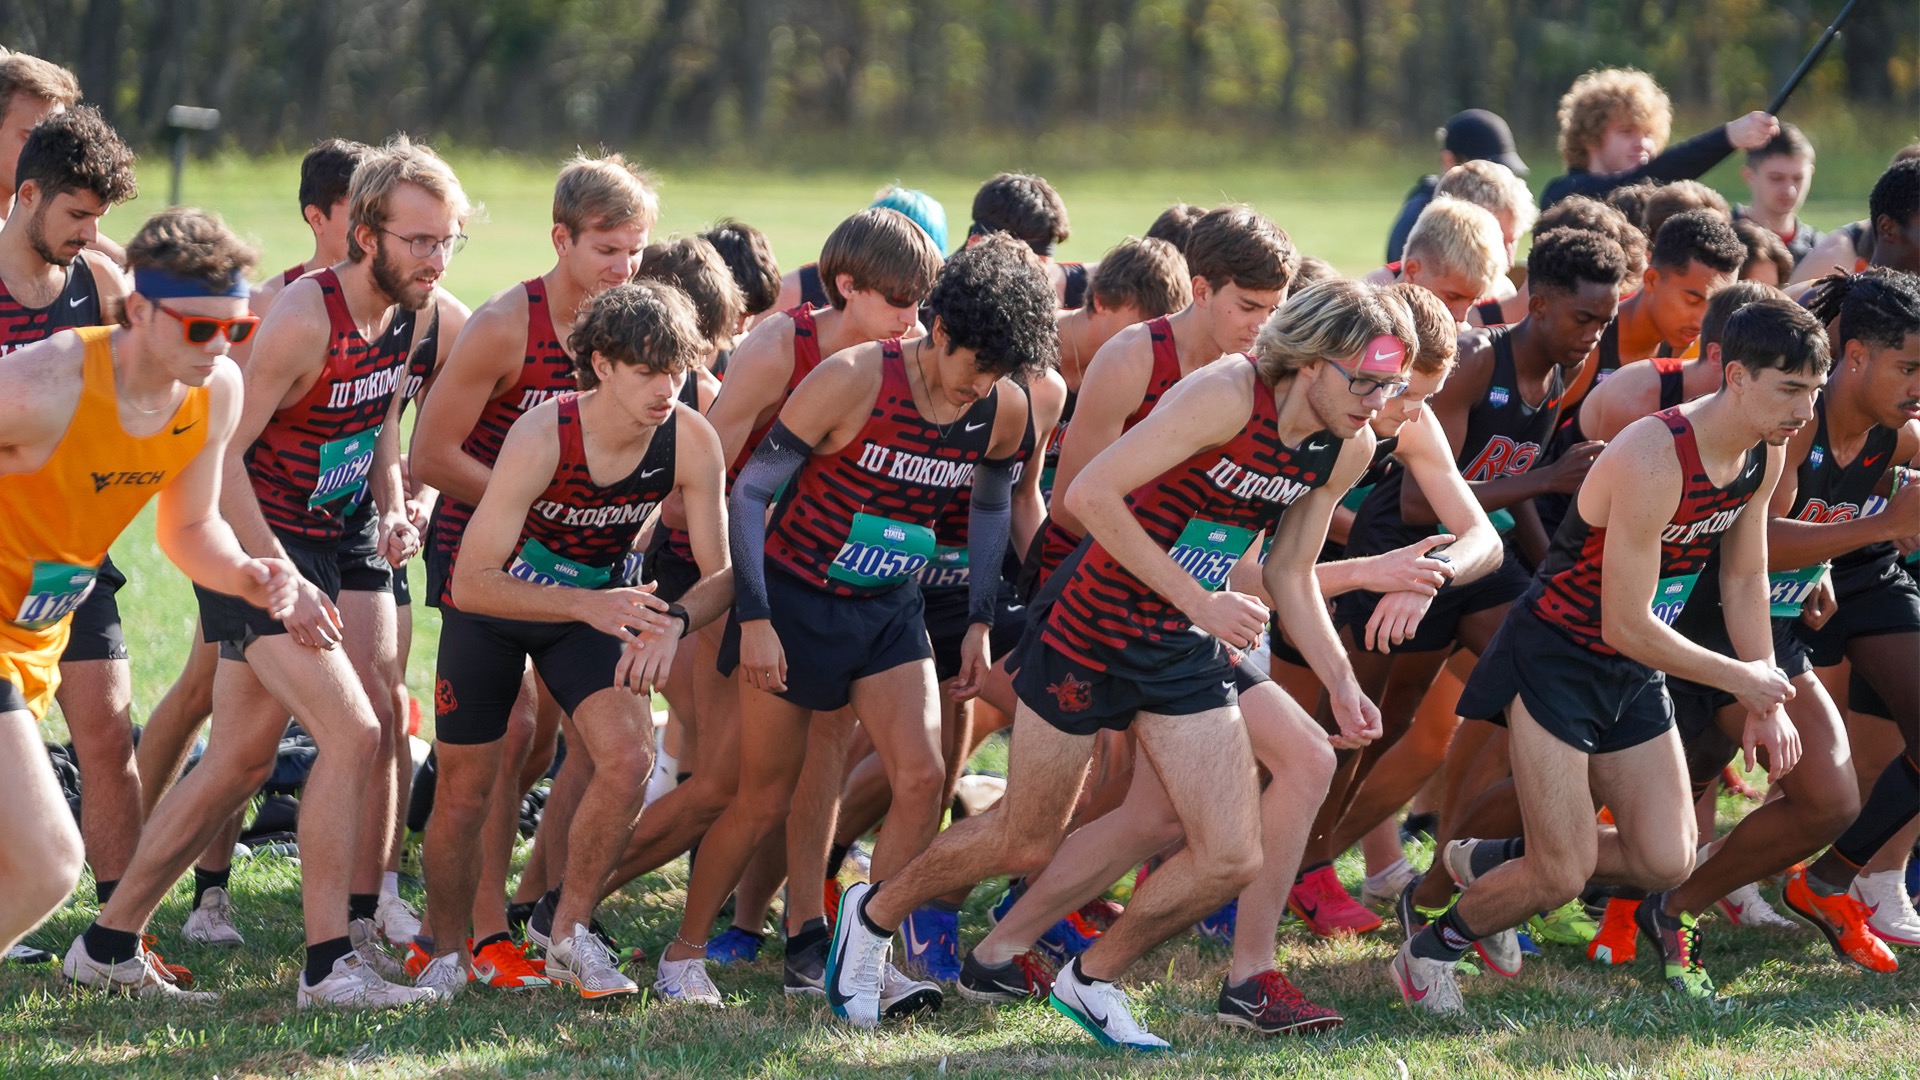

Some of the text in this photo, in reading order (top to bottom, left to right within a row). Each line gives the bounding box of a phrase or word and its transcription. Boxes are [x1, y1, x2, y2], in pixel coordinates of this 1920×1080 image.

[327, 381, 352, 408] IU
[114, 470, 166, 485] TECH
[311, 449, 374, 498] 4062
[857, 442, 890, 473] IU
[888, 451, 974, 487] KOKOMO
[1206, 457, 1242, 488] IU
[533, 500, 564, 520] IU
[1681, 503, 1747, 544] KKOM
[883, 528, 906, 541] STATES
[554, 563, 579, 577] STATES
[915, 564, 970, 586] 05
[1652, 600, 1685, 627] 06
